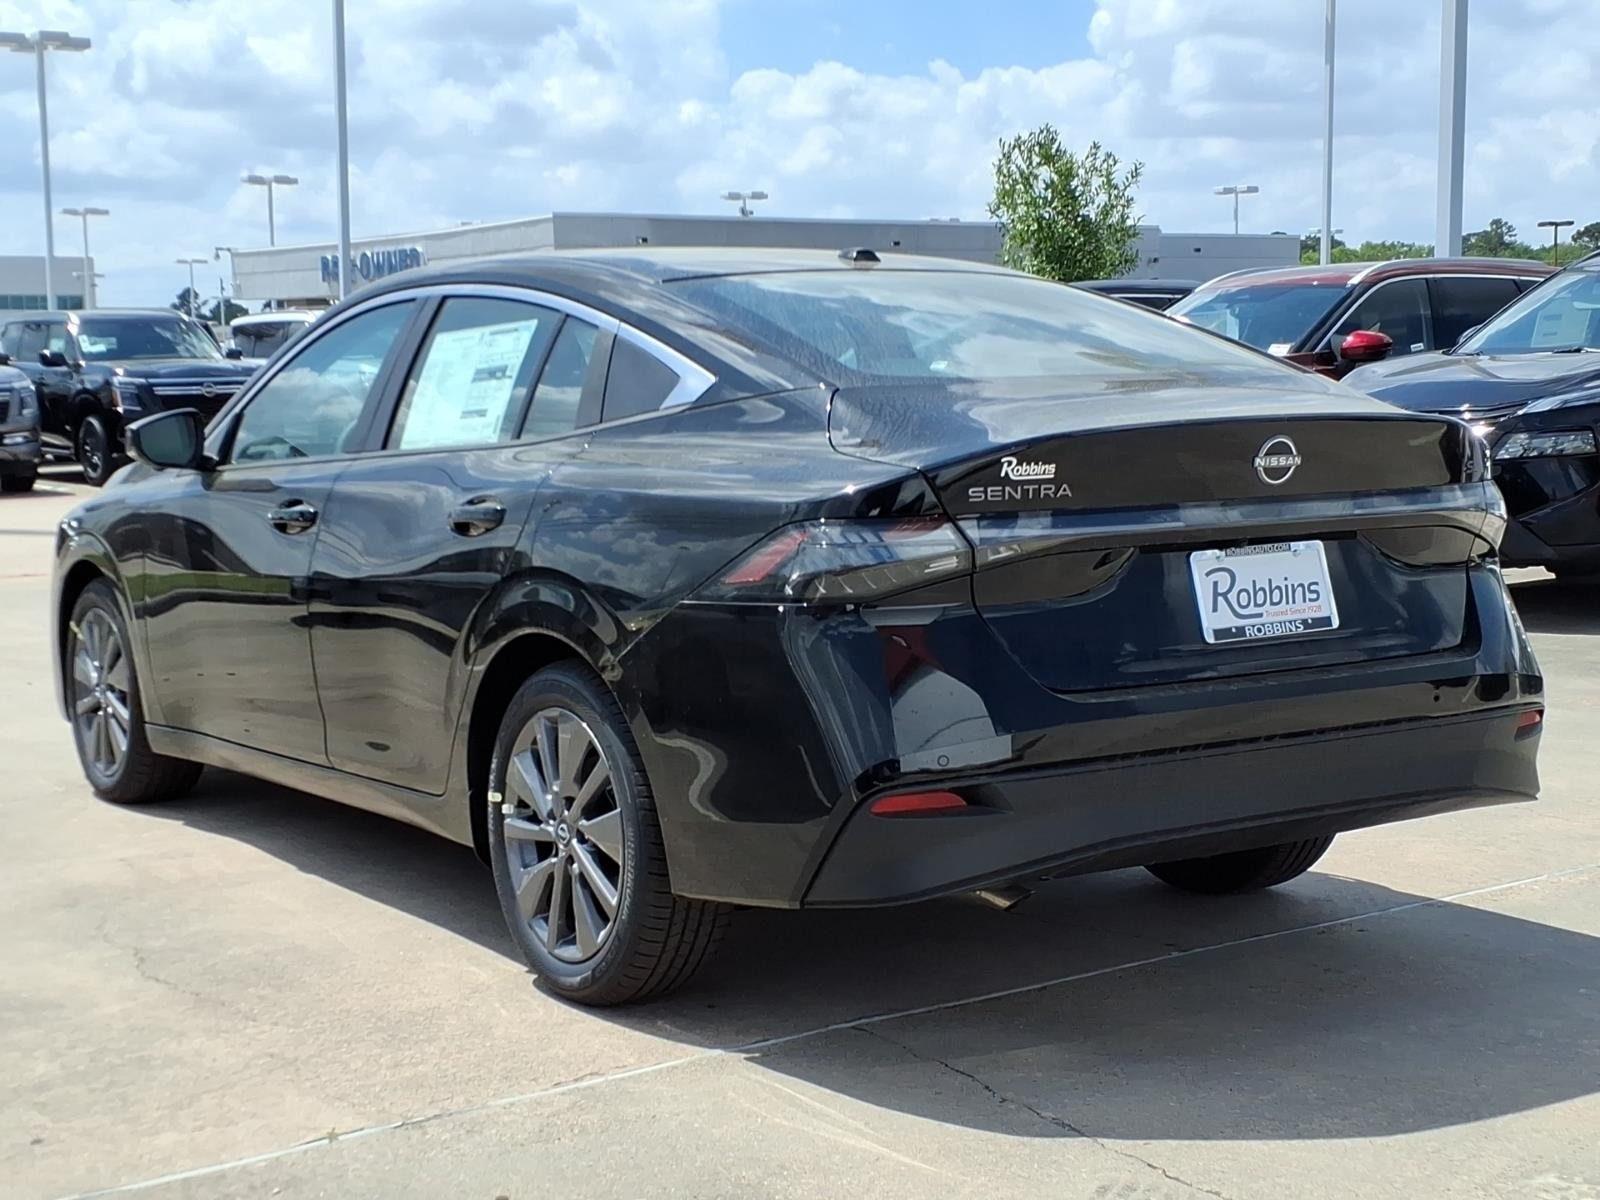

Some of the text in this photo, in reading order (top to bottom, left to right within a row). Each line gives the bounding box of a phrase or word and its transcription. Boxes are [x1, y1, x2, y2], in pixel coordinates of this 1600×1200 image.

[1000, 456, 1056, 480] Robbins
[1254, 455, 1302, 467] NISSAN
[968, 483, 1073, 502] SENTRA
[1204, 566, 1321, 620] Robbins
[1289, 607, 1307, 616] Since
[1245, 620, 1304, 638] ROBBINS
